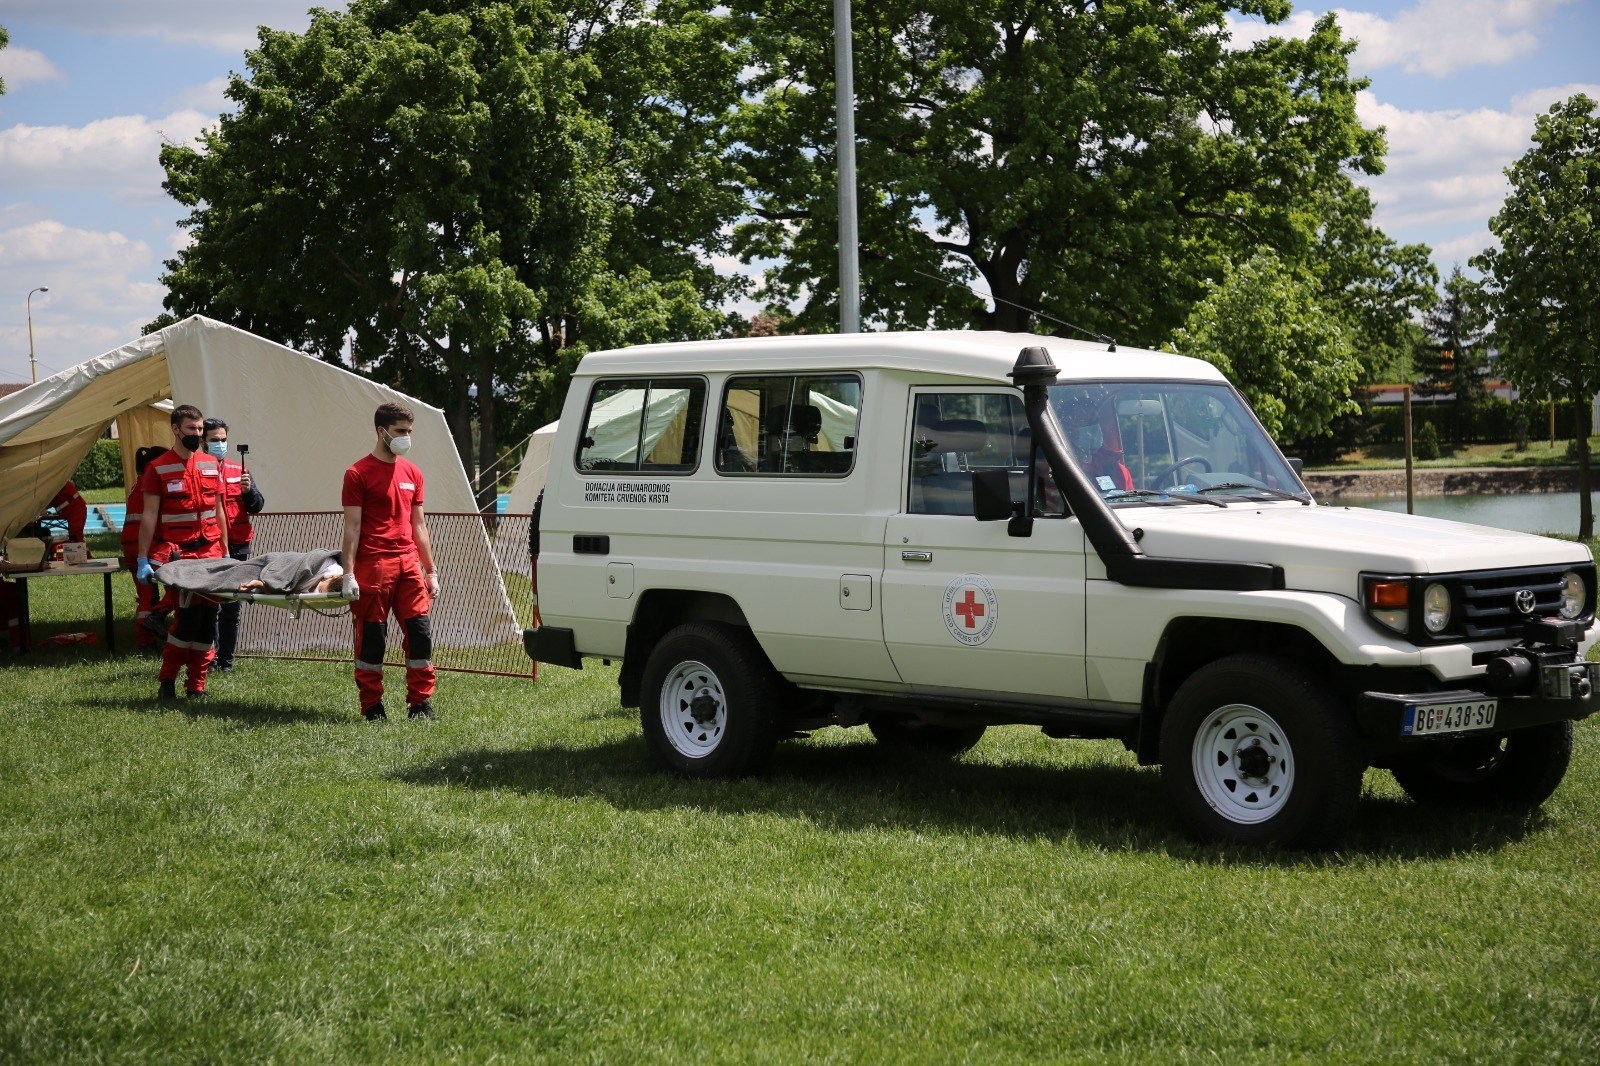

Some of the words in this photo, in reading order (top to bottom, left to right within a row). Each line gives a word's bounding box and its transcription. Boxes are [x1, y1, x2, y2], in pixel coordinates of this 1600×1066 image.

[585, 482, 615, 492] DONACIJA
[584, 493, 615, 502] KOMITETA
[617, 494, 647, 503] CRVENOG
[648, 494, 669, 503] KRSTA
[953, 628, 972, 642] CROSS
[973, 635, 981, 643] OF
[982, 616, 995, 638] SERBIA
[1416, 708, 1435, 732] BG
